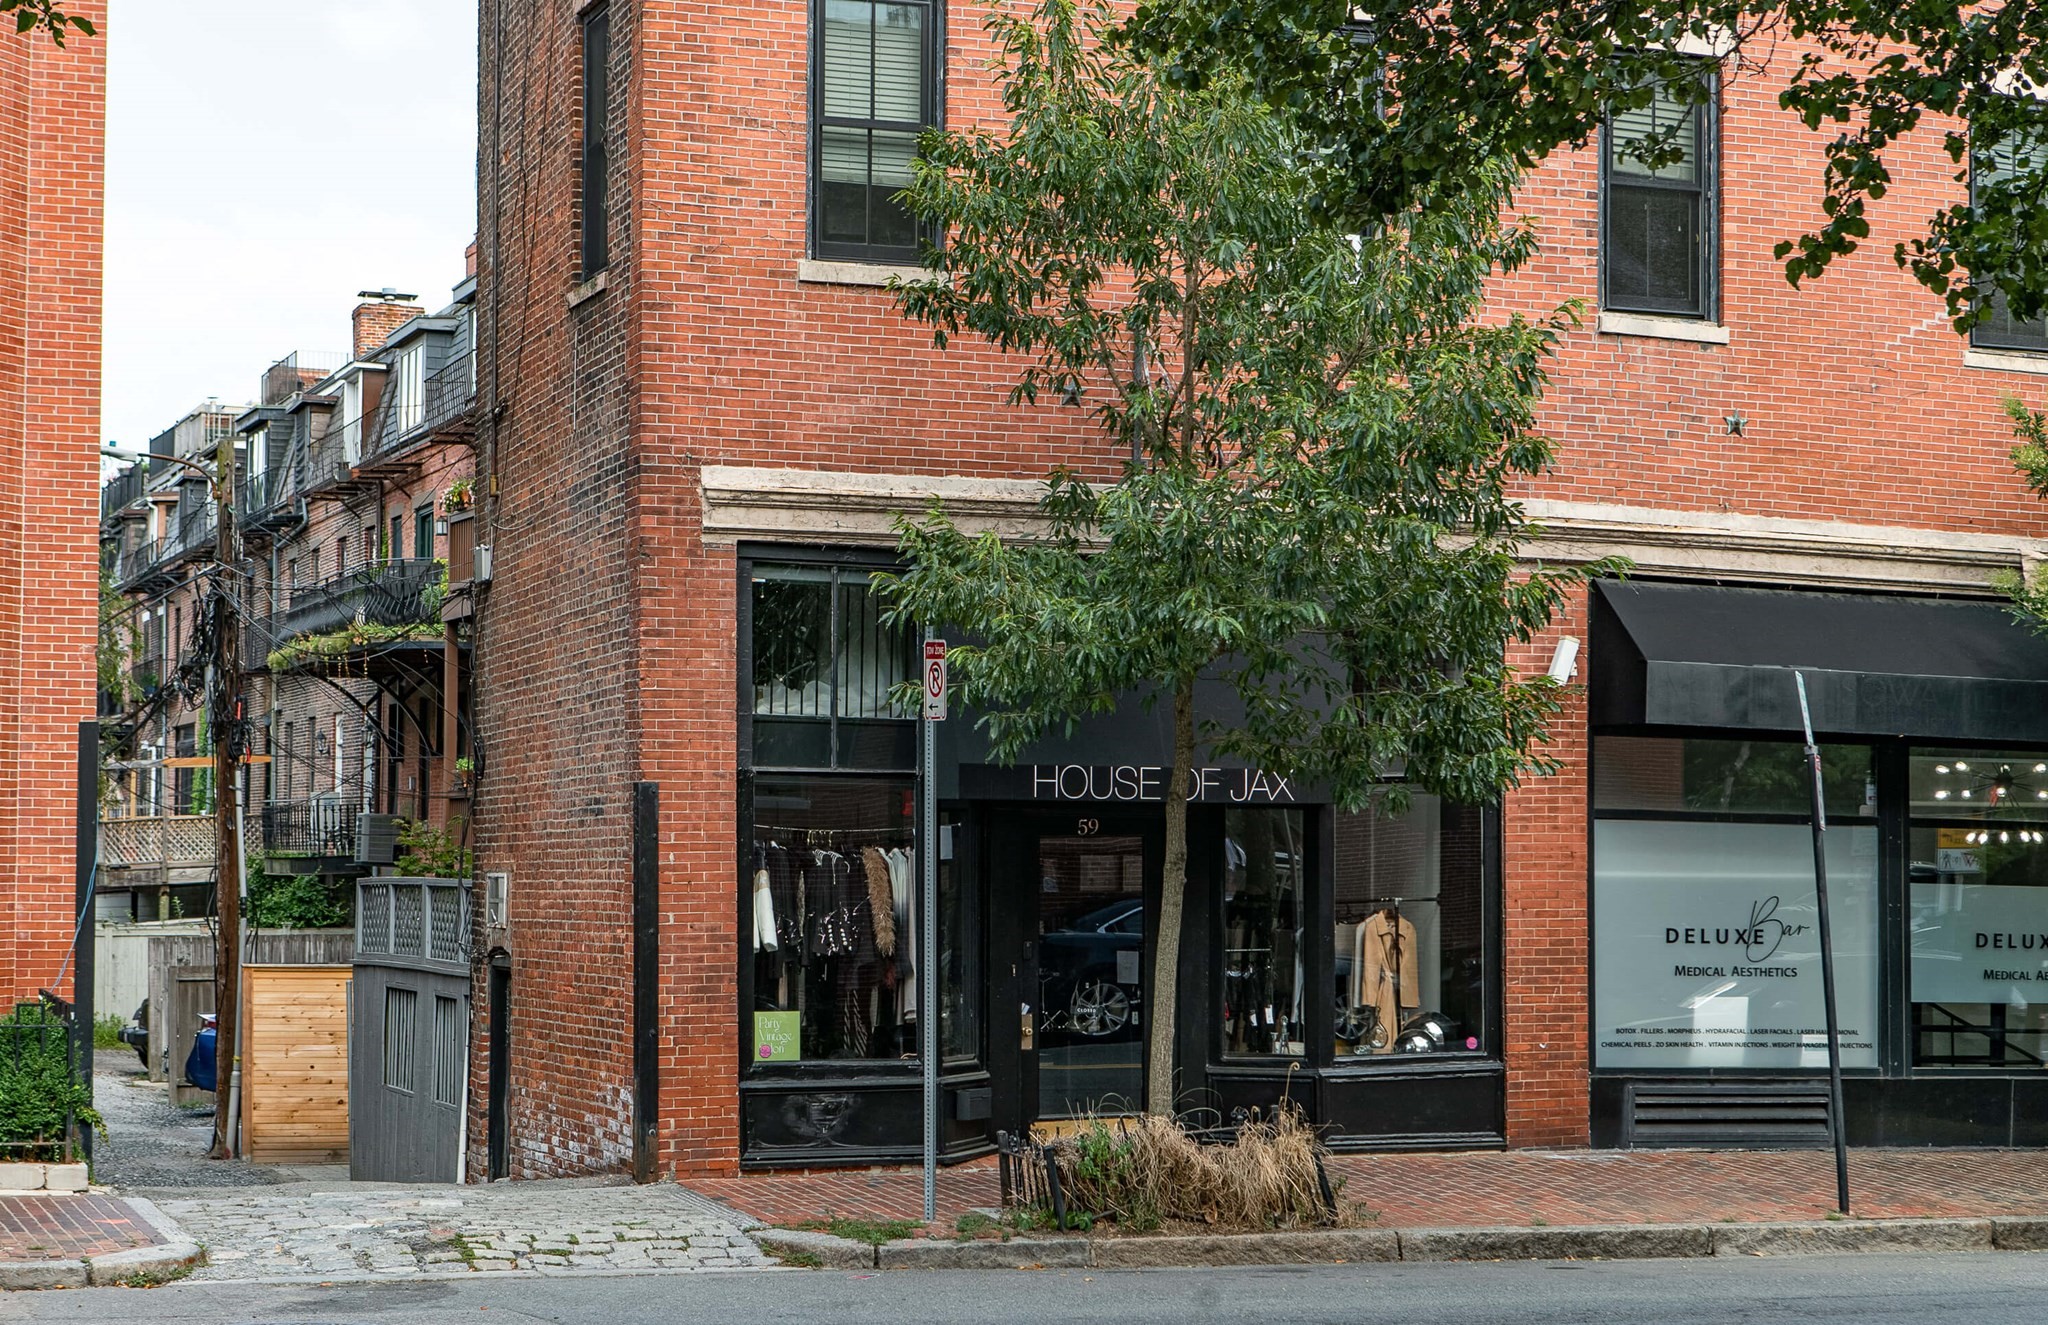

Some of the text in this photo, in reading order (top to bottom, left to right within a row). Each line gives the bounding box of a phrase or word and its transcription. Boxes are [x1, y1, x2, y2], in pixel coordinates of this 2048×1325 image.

[1034, 764, 1161, 801] HOUSE
[1229, 767, 1296, 801] JAX
[1077, 818, 1099, 836] 59
[1665, 895, 1811, 963] DELUXE Bar
[1674, 965, 1798, 978] MEDICAL AESTHETICS
[1983, 969, 2032, 981] MEDICAL
[758, 1016, 781, 1033] Party
[758, 1029, 793, 1045] Vintage
[1771, 1041, 1795, 1049] WEIGHT
